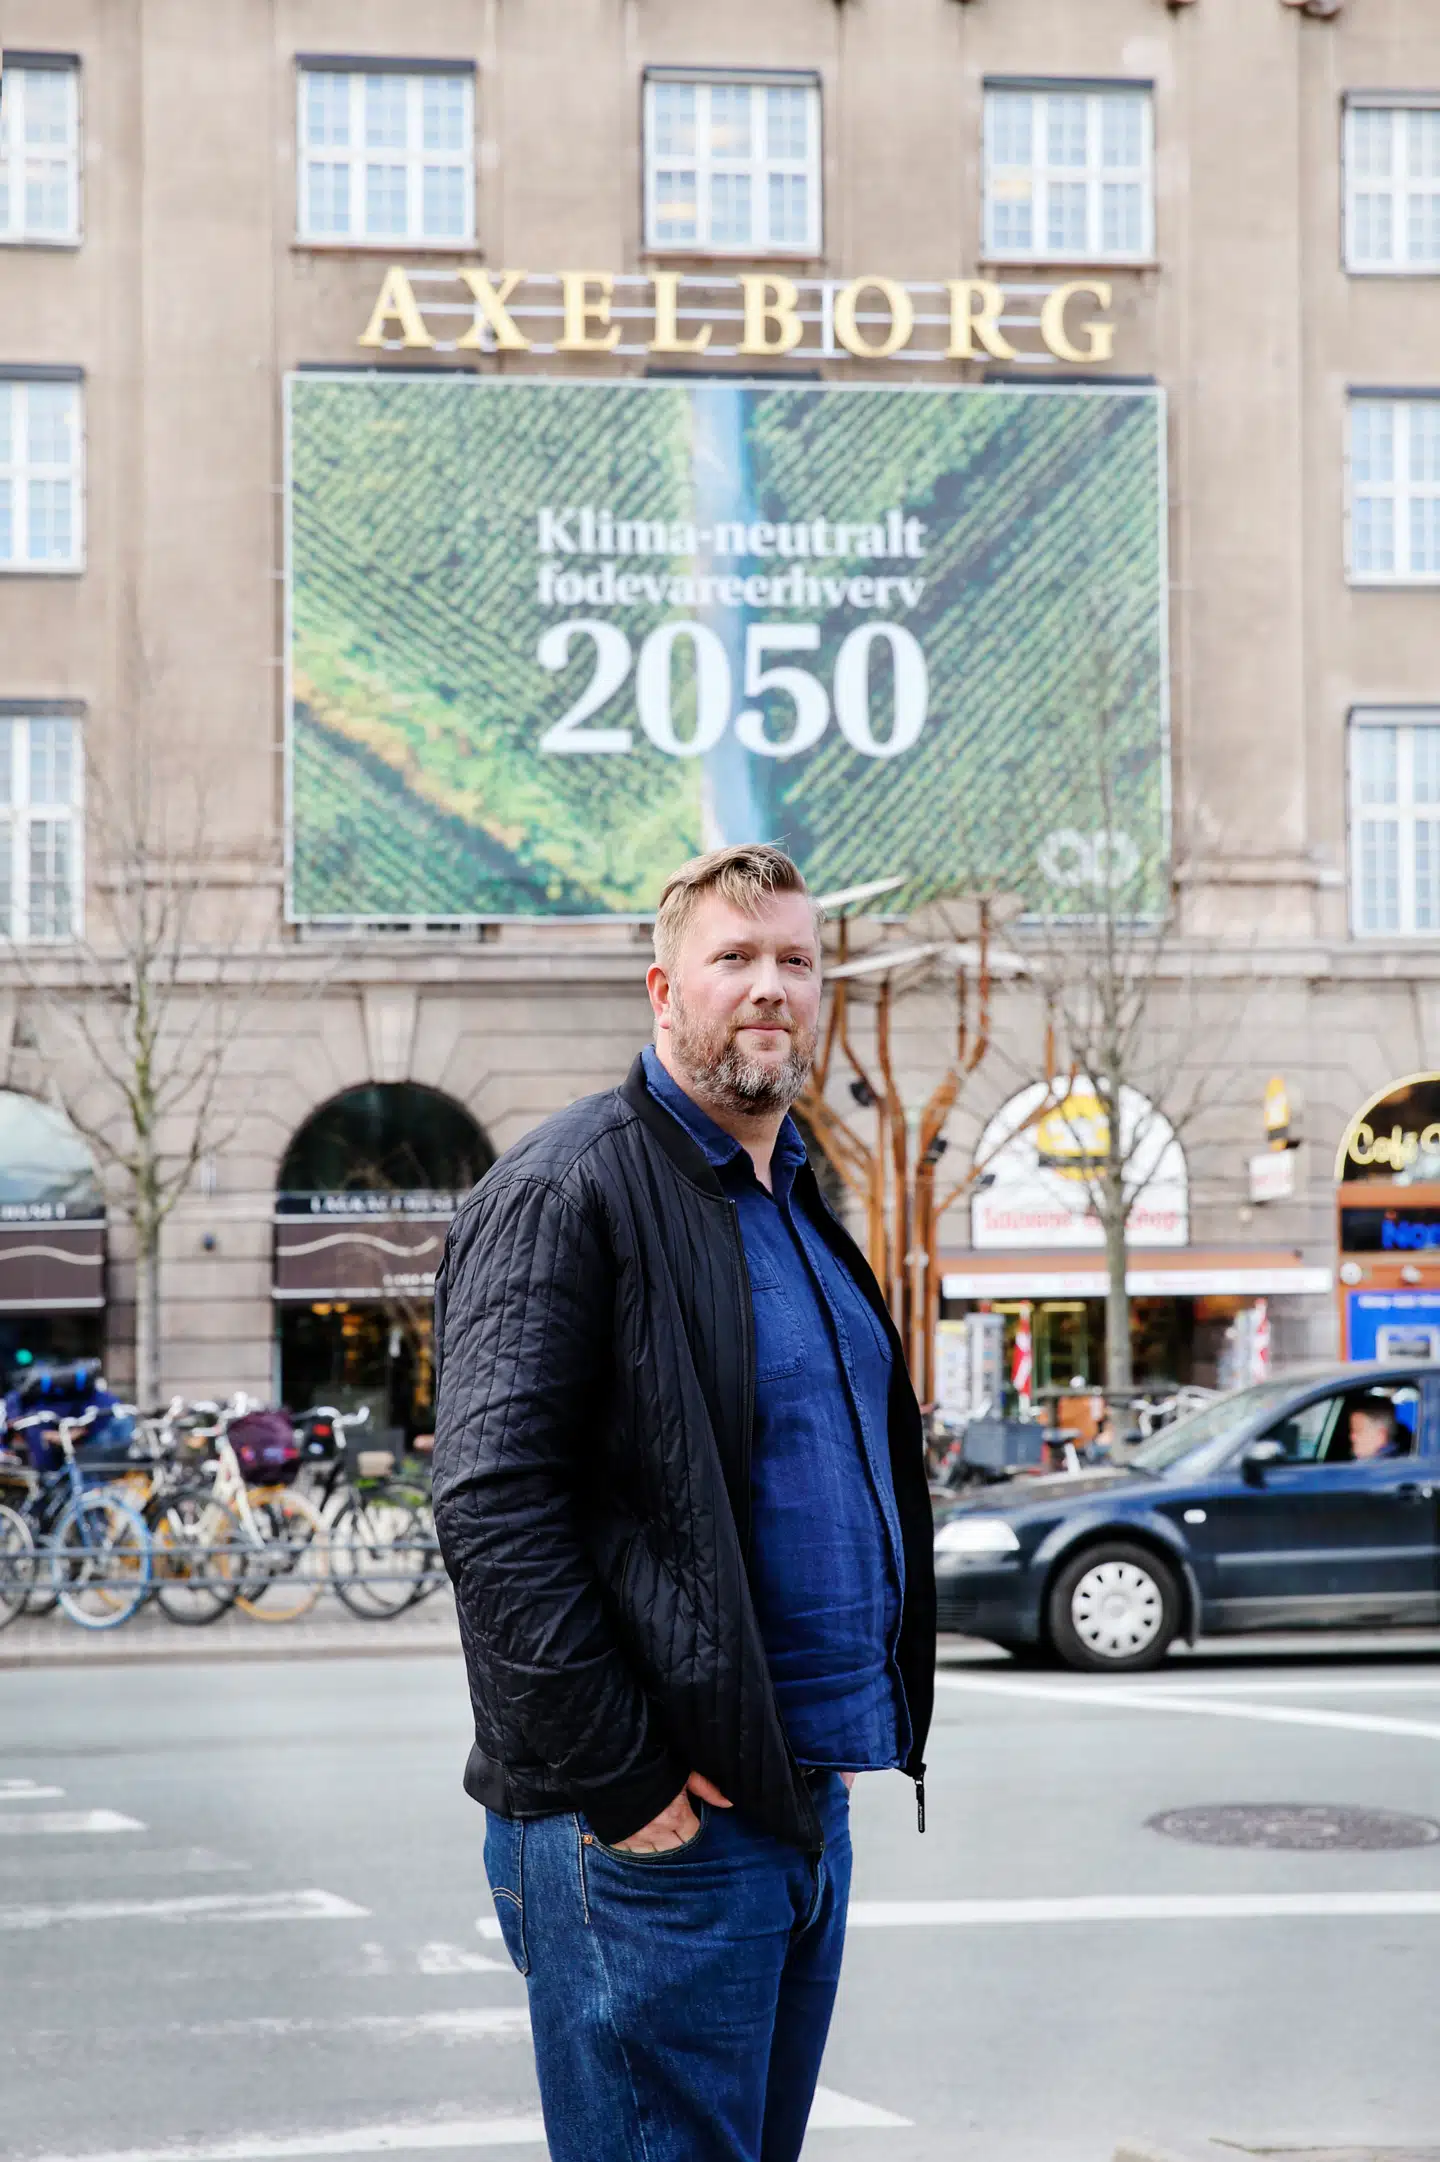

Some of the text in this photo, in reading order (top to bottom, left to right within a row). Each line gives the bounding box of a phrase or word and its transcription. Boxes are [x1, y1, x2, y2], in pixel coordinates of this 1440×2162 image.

[358, 265, 1116, 363] AXELBORG
[535, 505, 928, 558] Klima-neutralt
[536, 618, 930, 759] 2050
